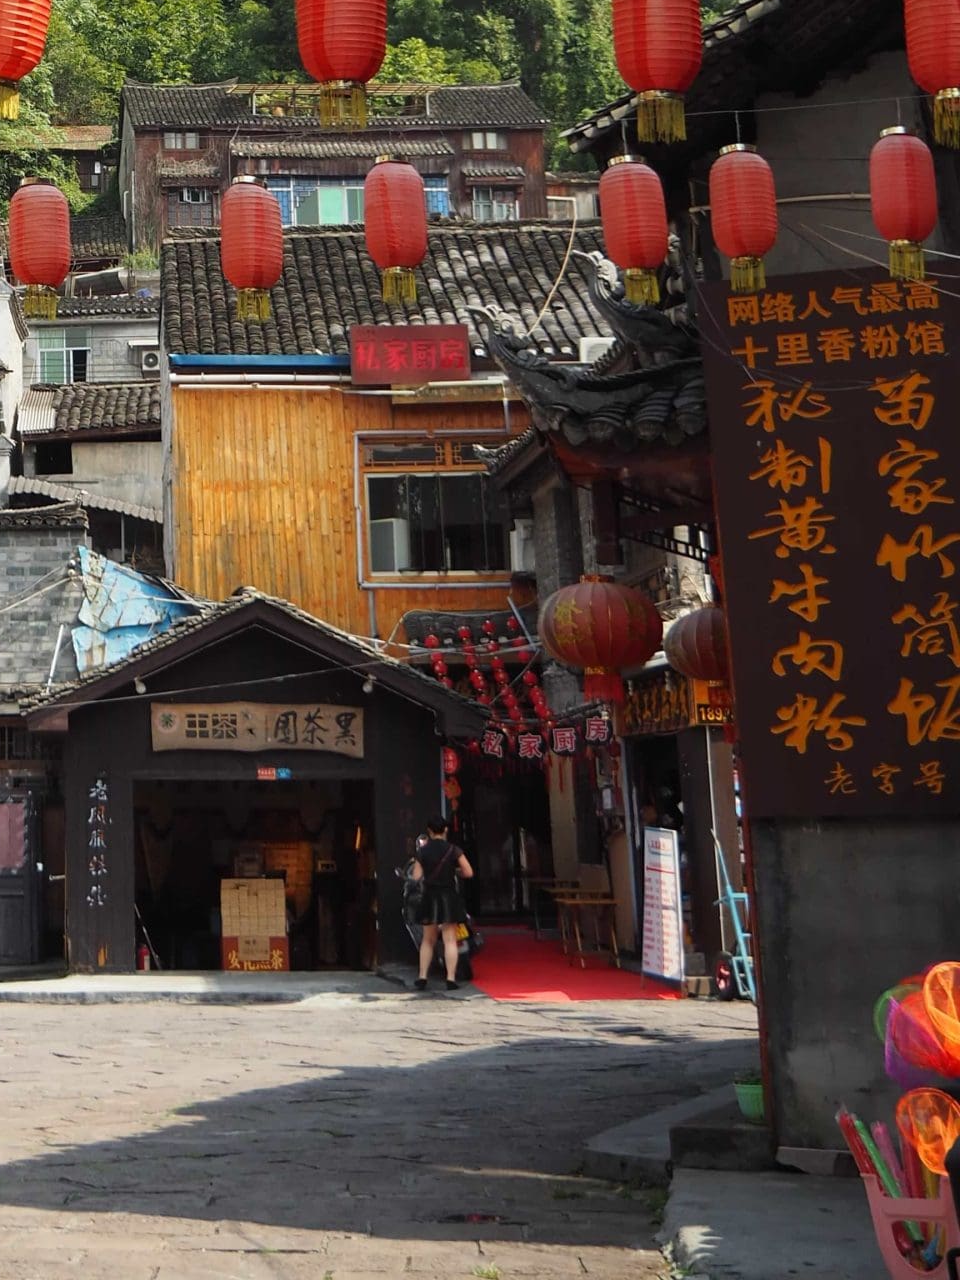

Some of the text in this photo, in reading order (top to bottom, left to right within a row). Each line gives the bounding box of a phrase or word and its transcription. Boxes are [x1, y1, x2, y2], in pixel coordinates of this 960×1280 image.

[727, 279, 940, 326] 网络人气最高
[355, 338, 466, 372] 私家厨房
[730, 321, 946, 370] 十里香粉馆
[741, 379, 867, 755] 秘制黄牛肉粉
[867, 369, 960, 748] 苗家竹筒饭
[481, 716, 609, 758] 私家厨房
[823, 760, 946, 796] 老字号
